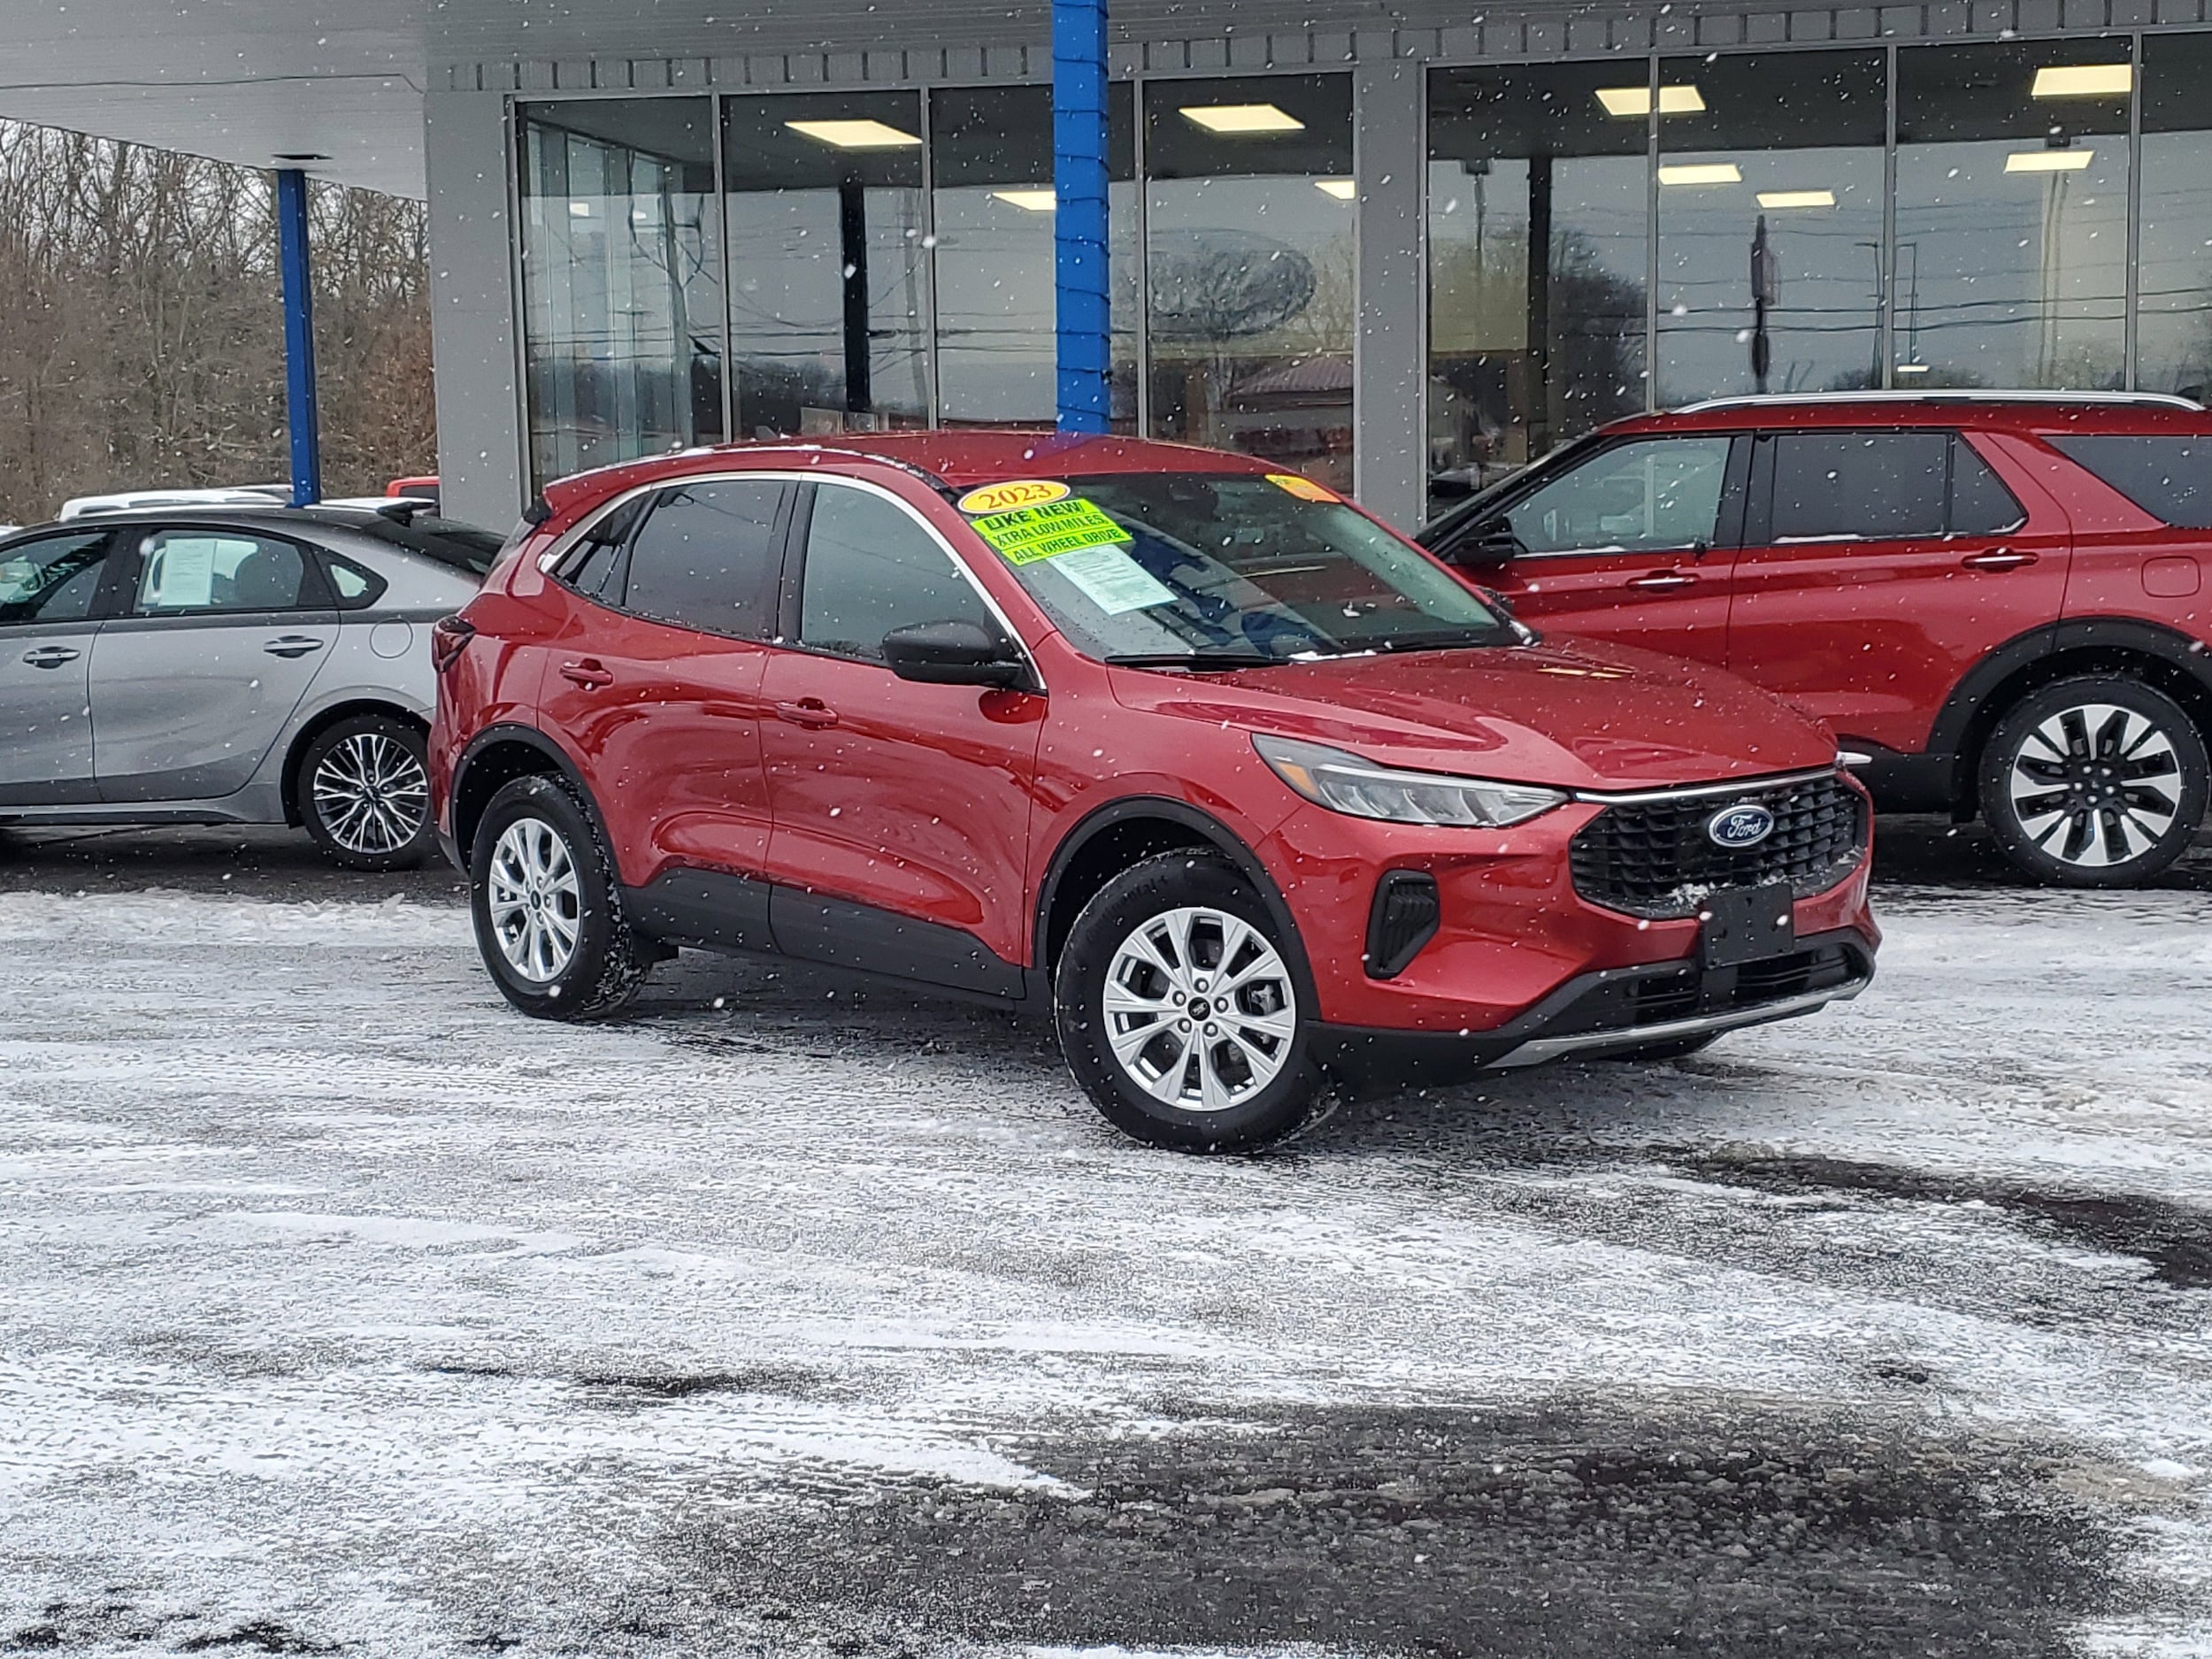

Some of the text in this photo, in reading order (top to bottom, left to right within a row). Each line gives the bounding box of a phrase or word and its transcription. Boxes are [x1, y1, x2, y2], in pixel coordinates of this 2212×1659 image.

[979, 484, 1052, 510] 2023
[984, 501, 1085, 532] LIKE NEW
[993, 514, 1105, 547] XTRA LOW MILES
[1012, 528, 1122, 562] ALL WHEEL DRIVE
[1727, 814, 1762, 839] Ford
